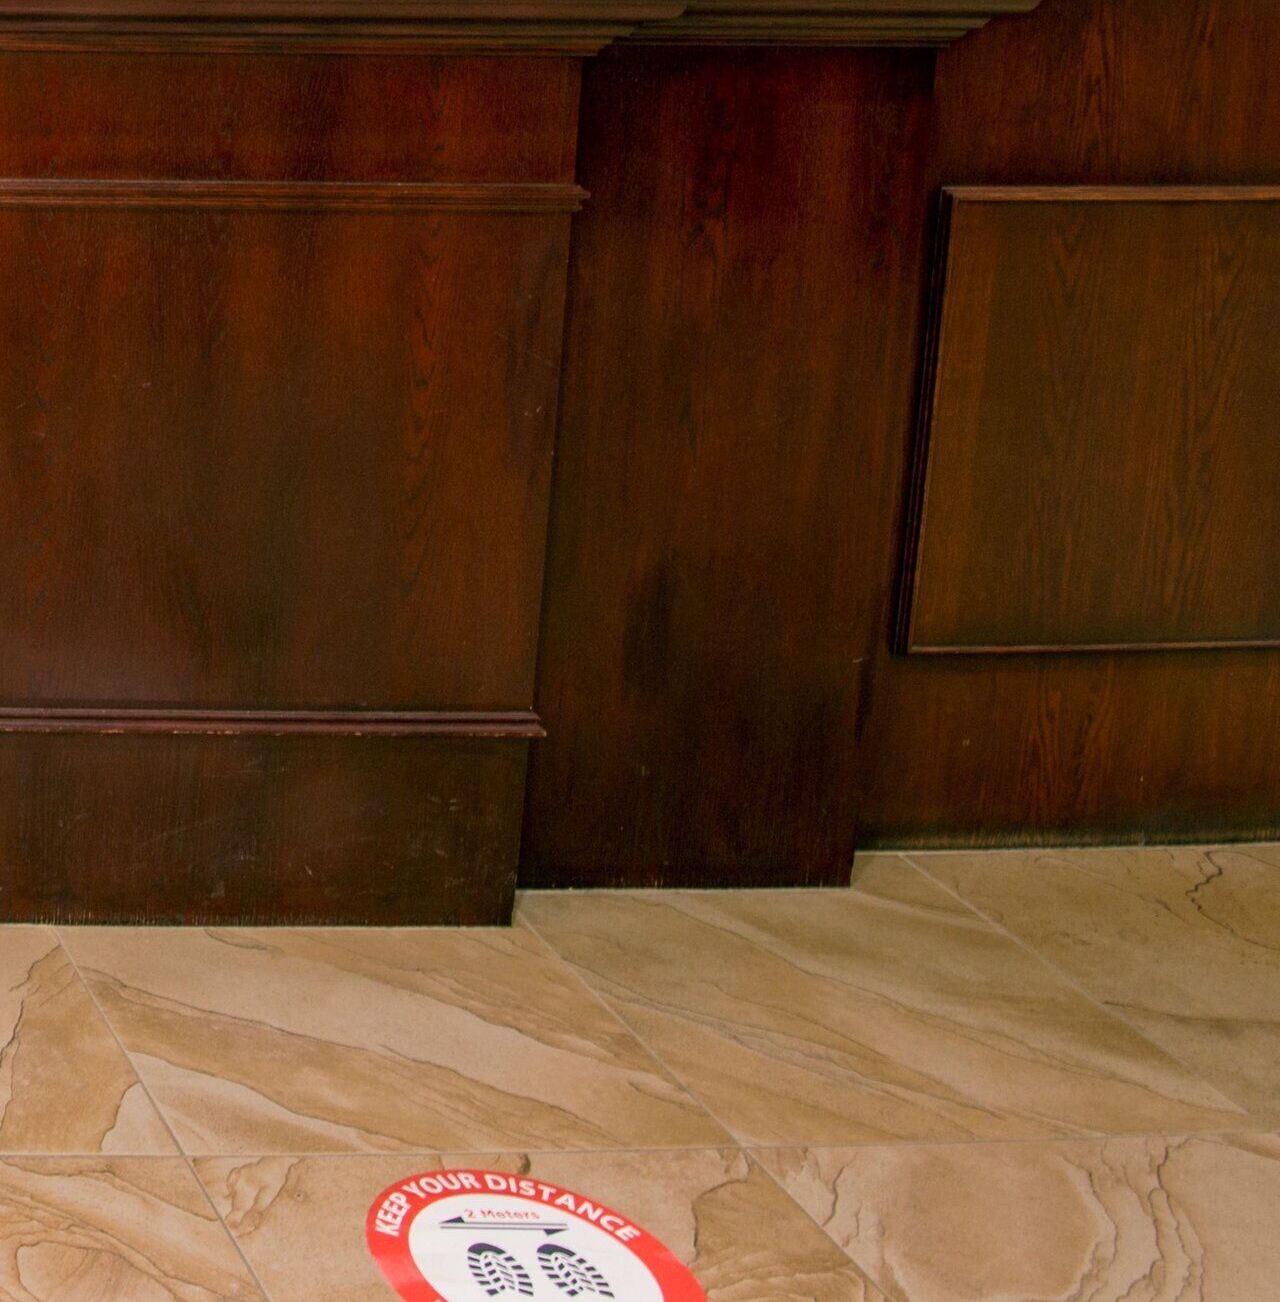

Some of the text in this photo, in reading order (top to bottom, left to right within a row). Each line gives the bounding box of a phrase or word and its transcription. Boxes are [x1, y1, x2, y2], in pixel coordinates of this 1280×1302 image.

[375, 1172, 641, 1242] KEEP YOUR DISTANCE
[464, 1208, 476, 1219] 2
